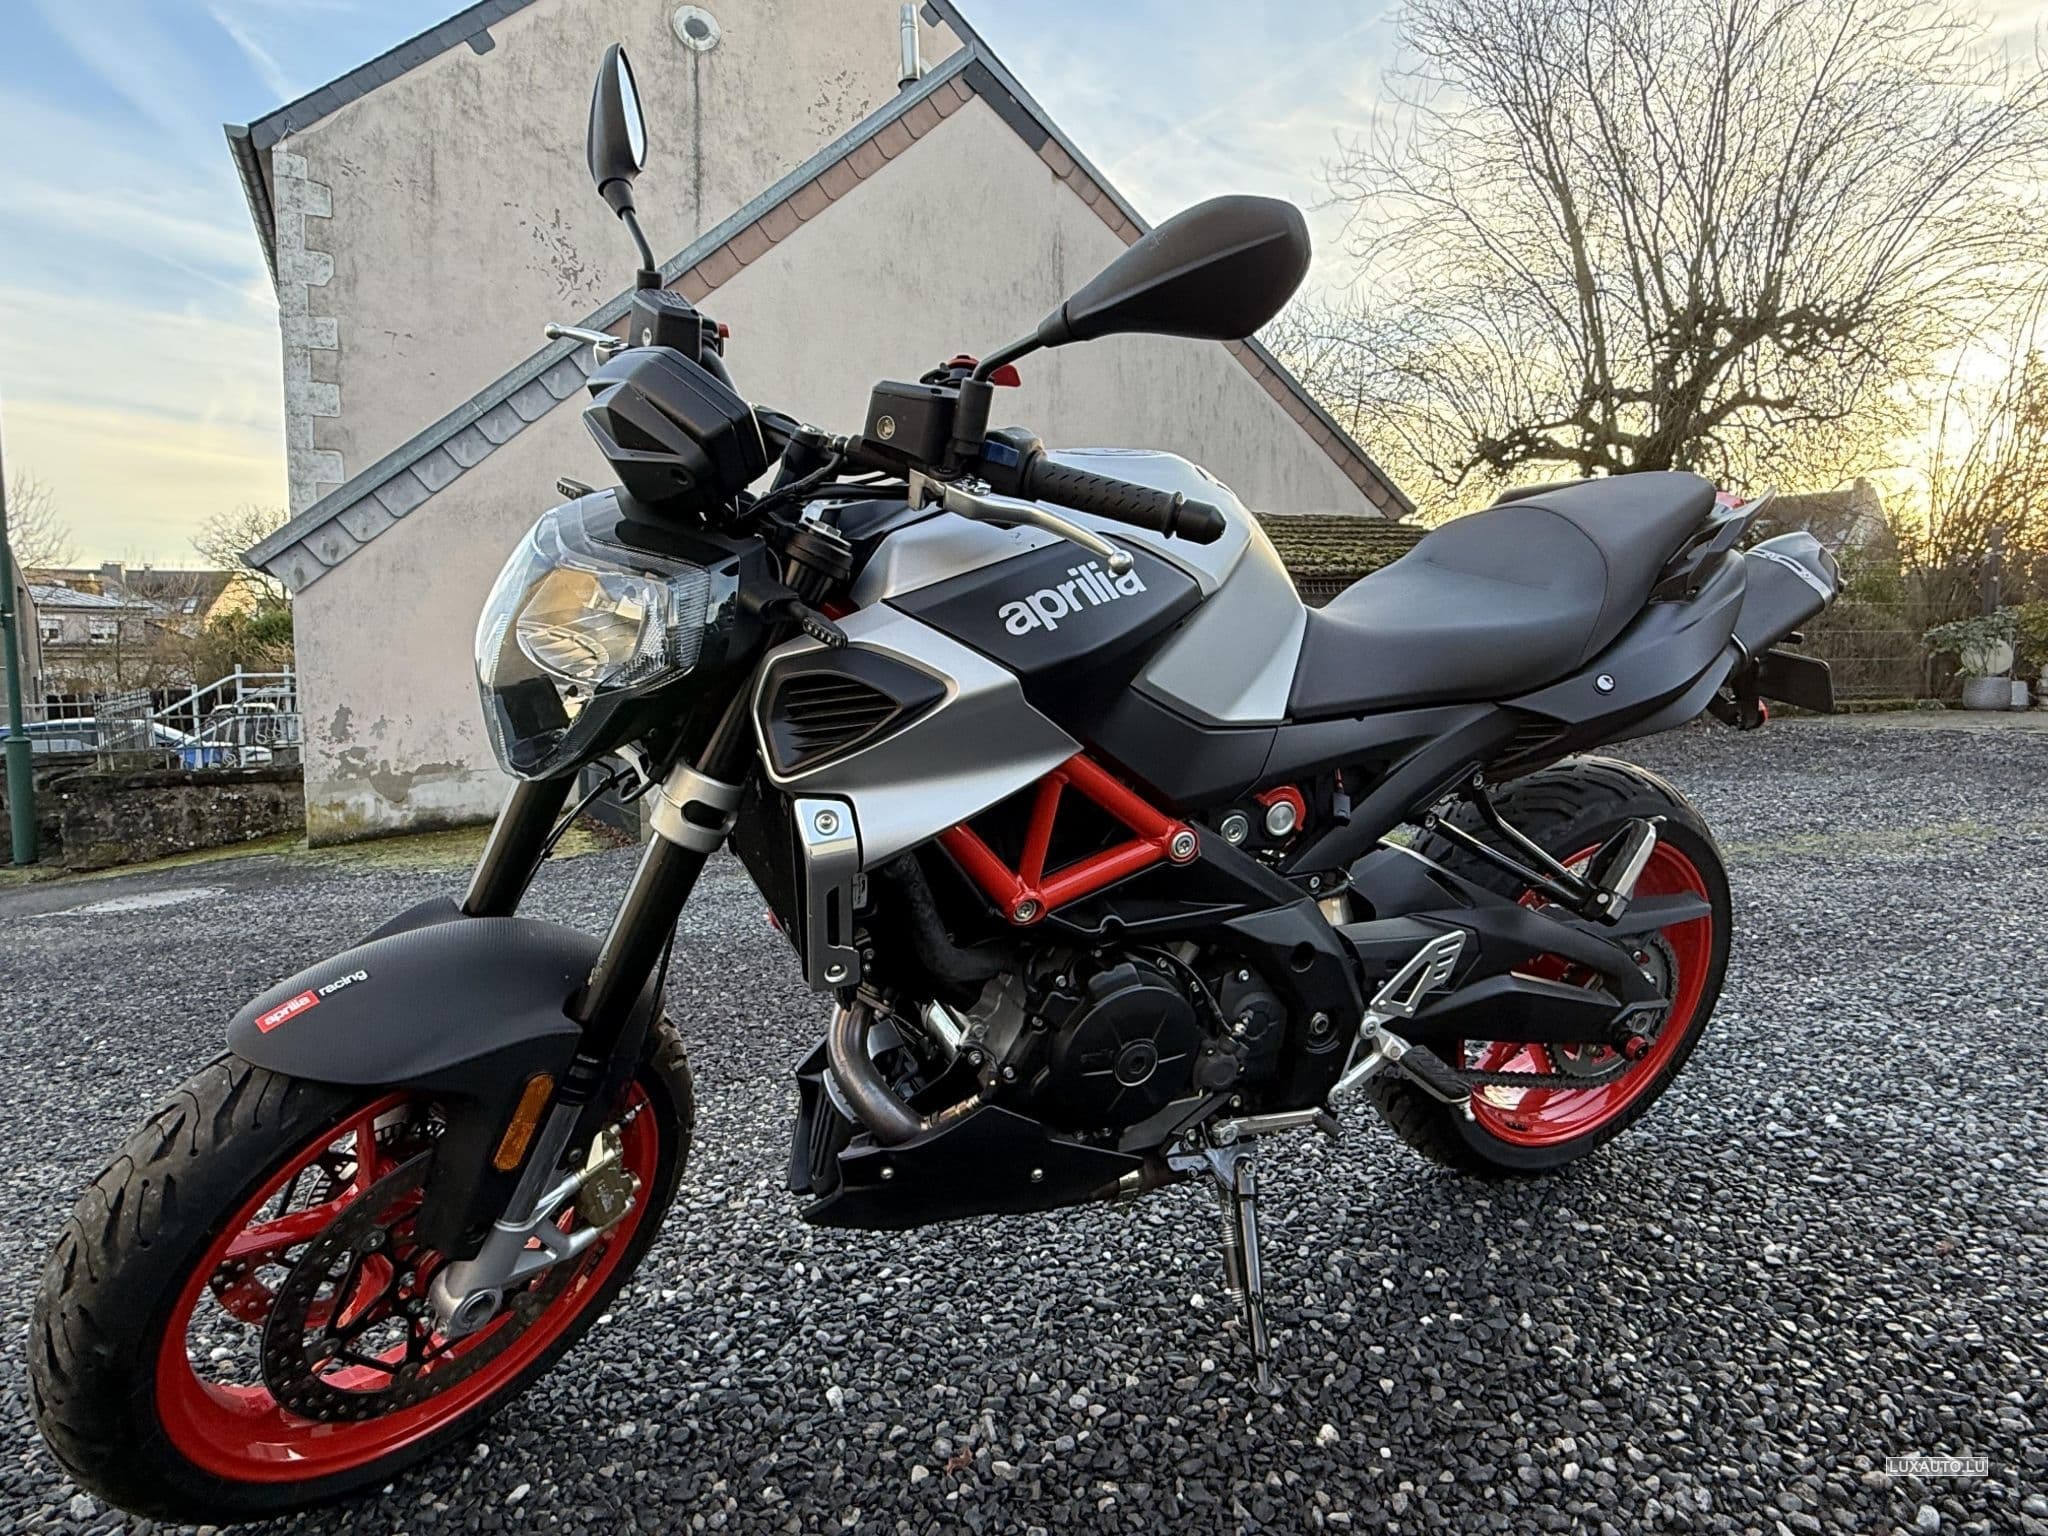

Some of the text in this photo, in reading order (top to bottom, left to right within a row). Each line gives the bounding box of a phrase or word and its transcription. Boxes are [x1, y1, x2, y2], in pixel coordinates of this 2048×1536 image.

[998, 561, 1147, 635] aprilia
[264, 969, 369, 1026] aprilia racing
